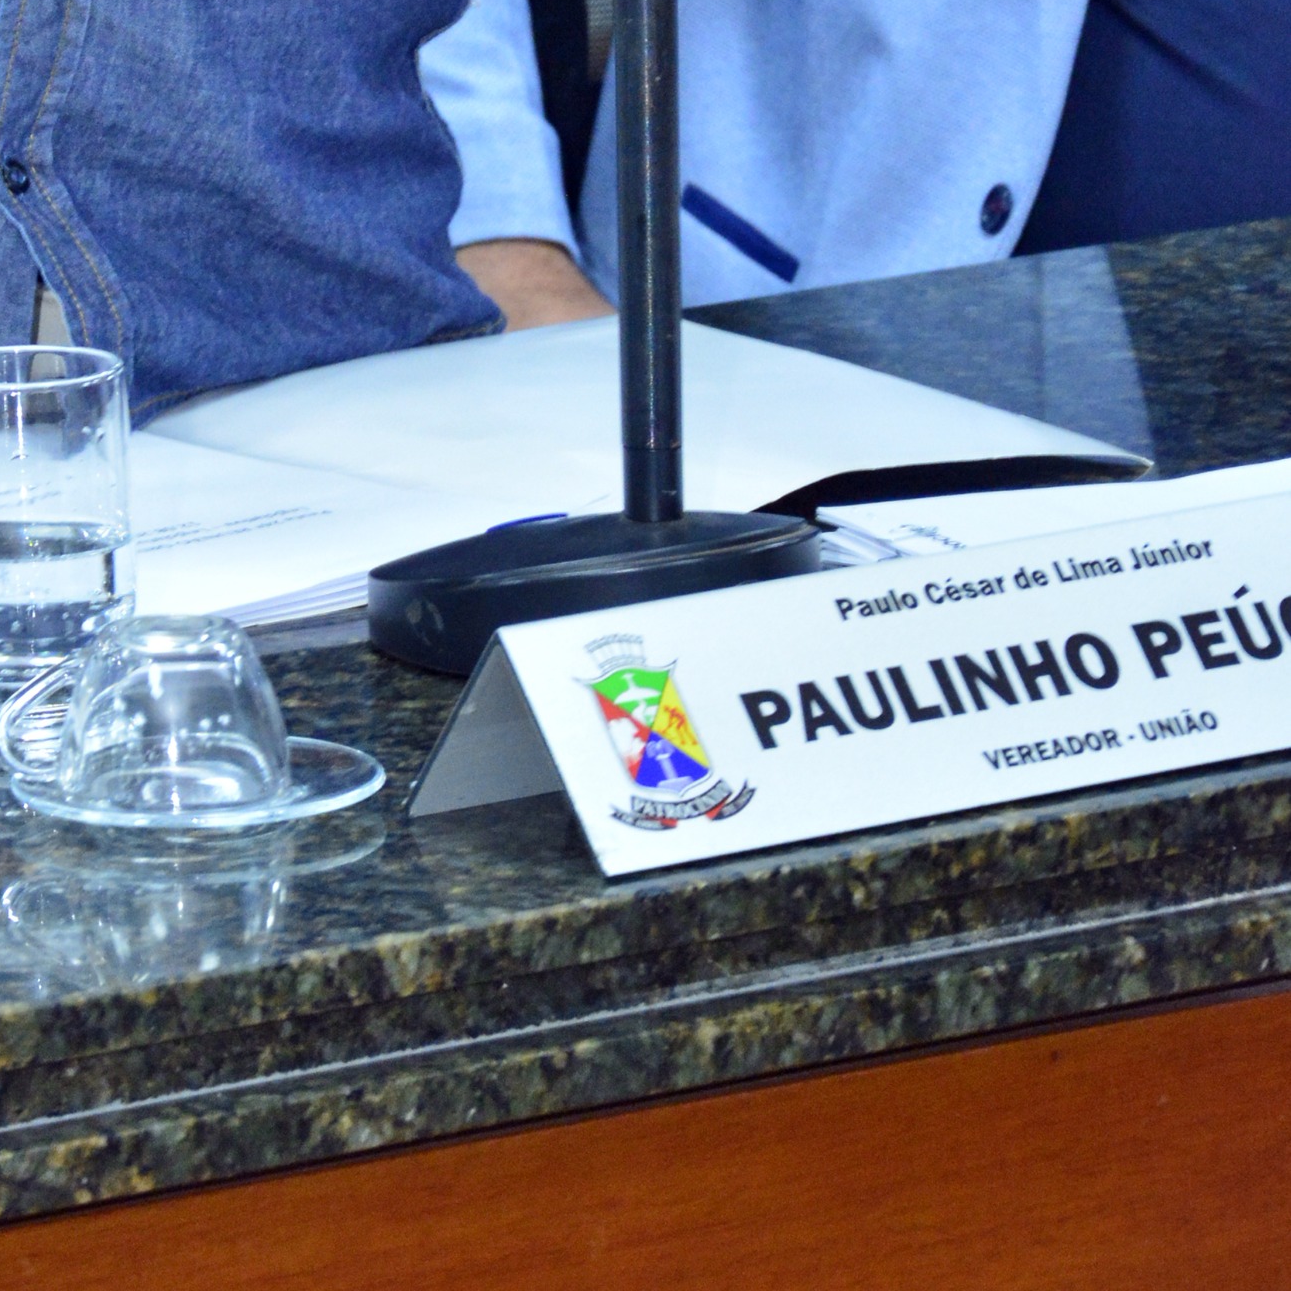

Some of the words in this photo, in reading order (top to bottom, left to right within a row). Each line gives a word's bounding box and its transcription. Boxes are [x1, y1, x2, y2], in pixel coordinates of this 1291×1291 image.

[835, 591, 918, 620] Paulo
[923, 578, 1005, 605] César
[1013, 567, 1050, 590] de
[1053, 554, 1123, 583] Lima
[1131, 540, 1214, 571] Júnior
[739, 632, 1121, 750] PAULINHO
[983, 727, 1120, 771] VEREADOR
[1139, 709, 1220, 743] UNIÃO
